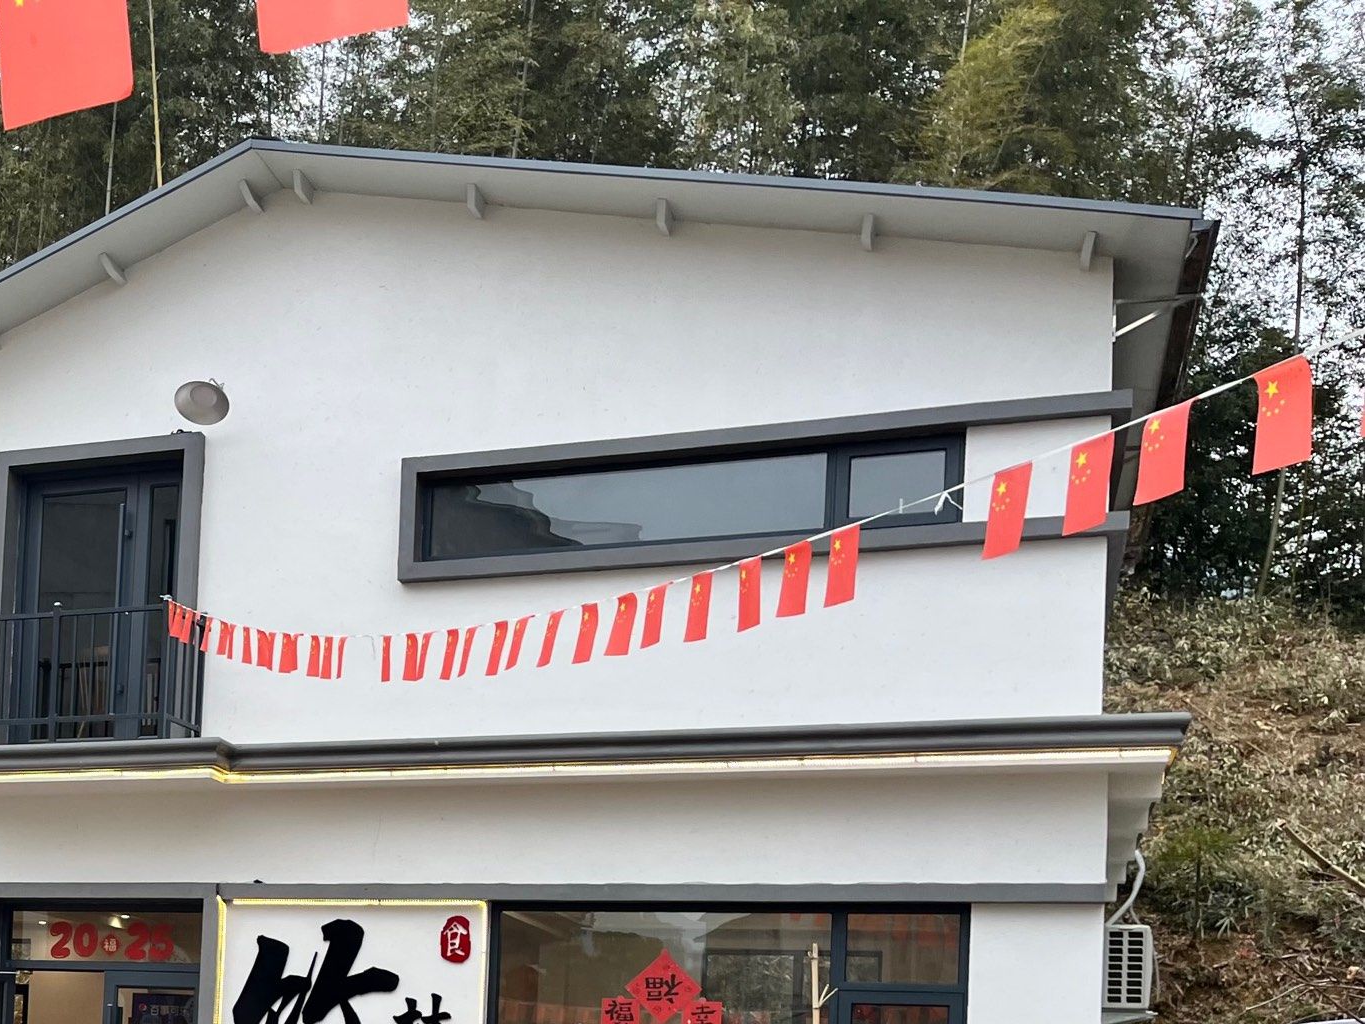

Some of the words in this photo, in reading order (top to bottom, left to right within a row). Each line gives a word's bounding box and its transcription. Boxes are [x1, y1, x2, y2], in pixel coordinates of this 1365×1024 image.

[104, 938, 117, 952] 福
[443, 922, 468, 957] 食
[645, 973, 683, 1004] 福
